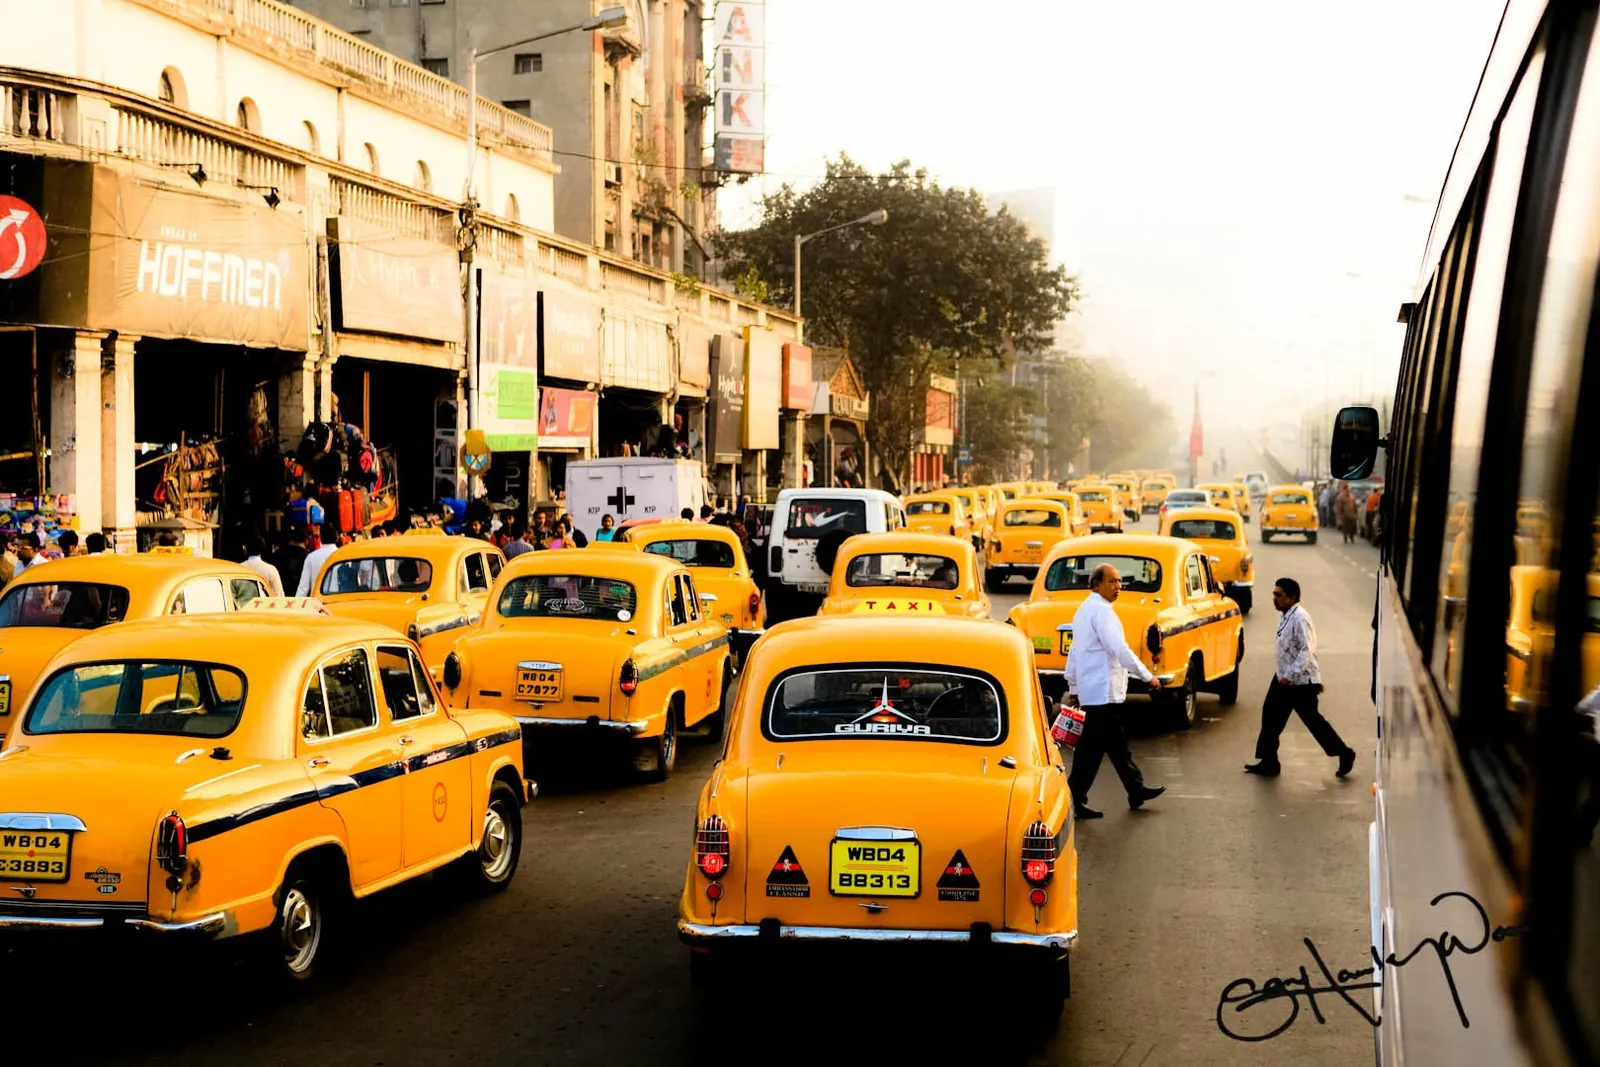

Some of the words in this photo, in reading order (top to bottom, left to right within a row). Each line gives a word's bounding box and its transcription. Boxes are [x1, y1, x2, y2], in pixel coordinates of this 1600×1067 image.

[254, 599, 307, 608] TAXI
[866, 601, 932, 610] TAXI
[523, 671, 555, 682] WB04
[835, 723, 930, 735] GURIYA
[3, 835, 61, 848] WB04
[848, 847, 905, 862] WB04
[839, 873, 910, 888] B8313
